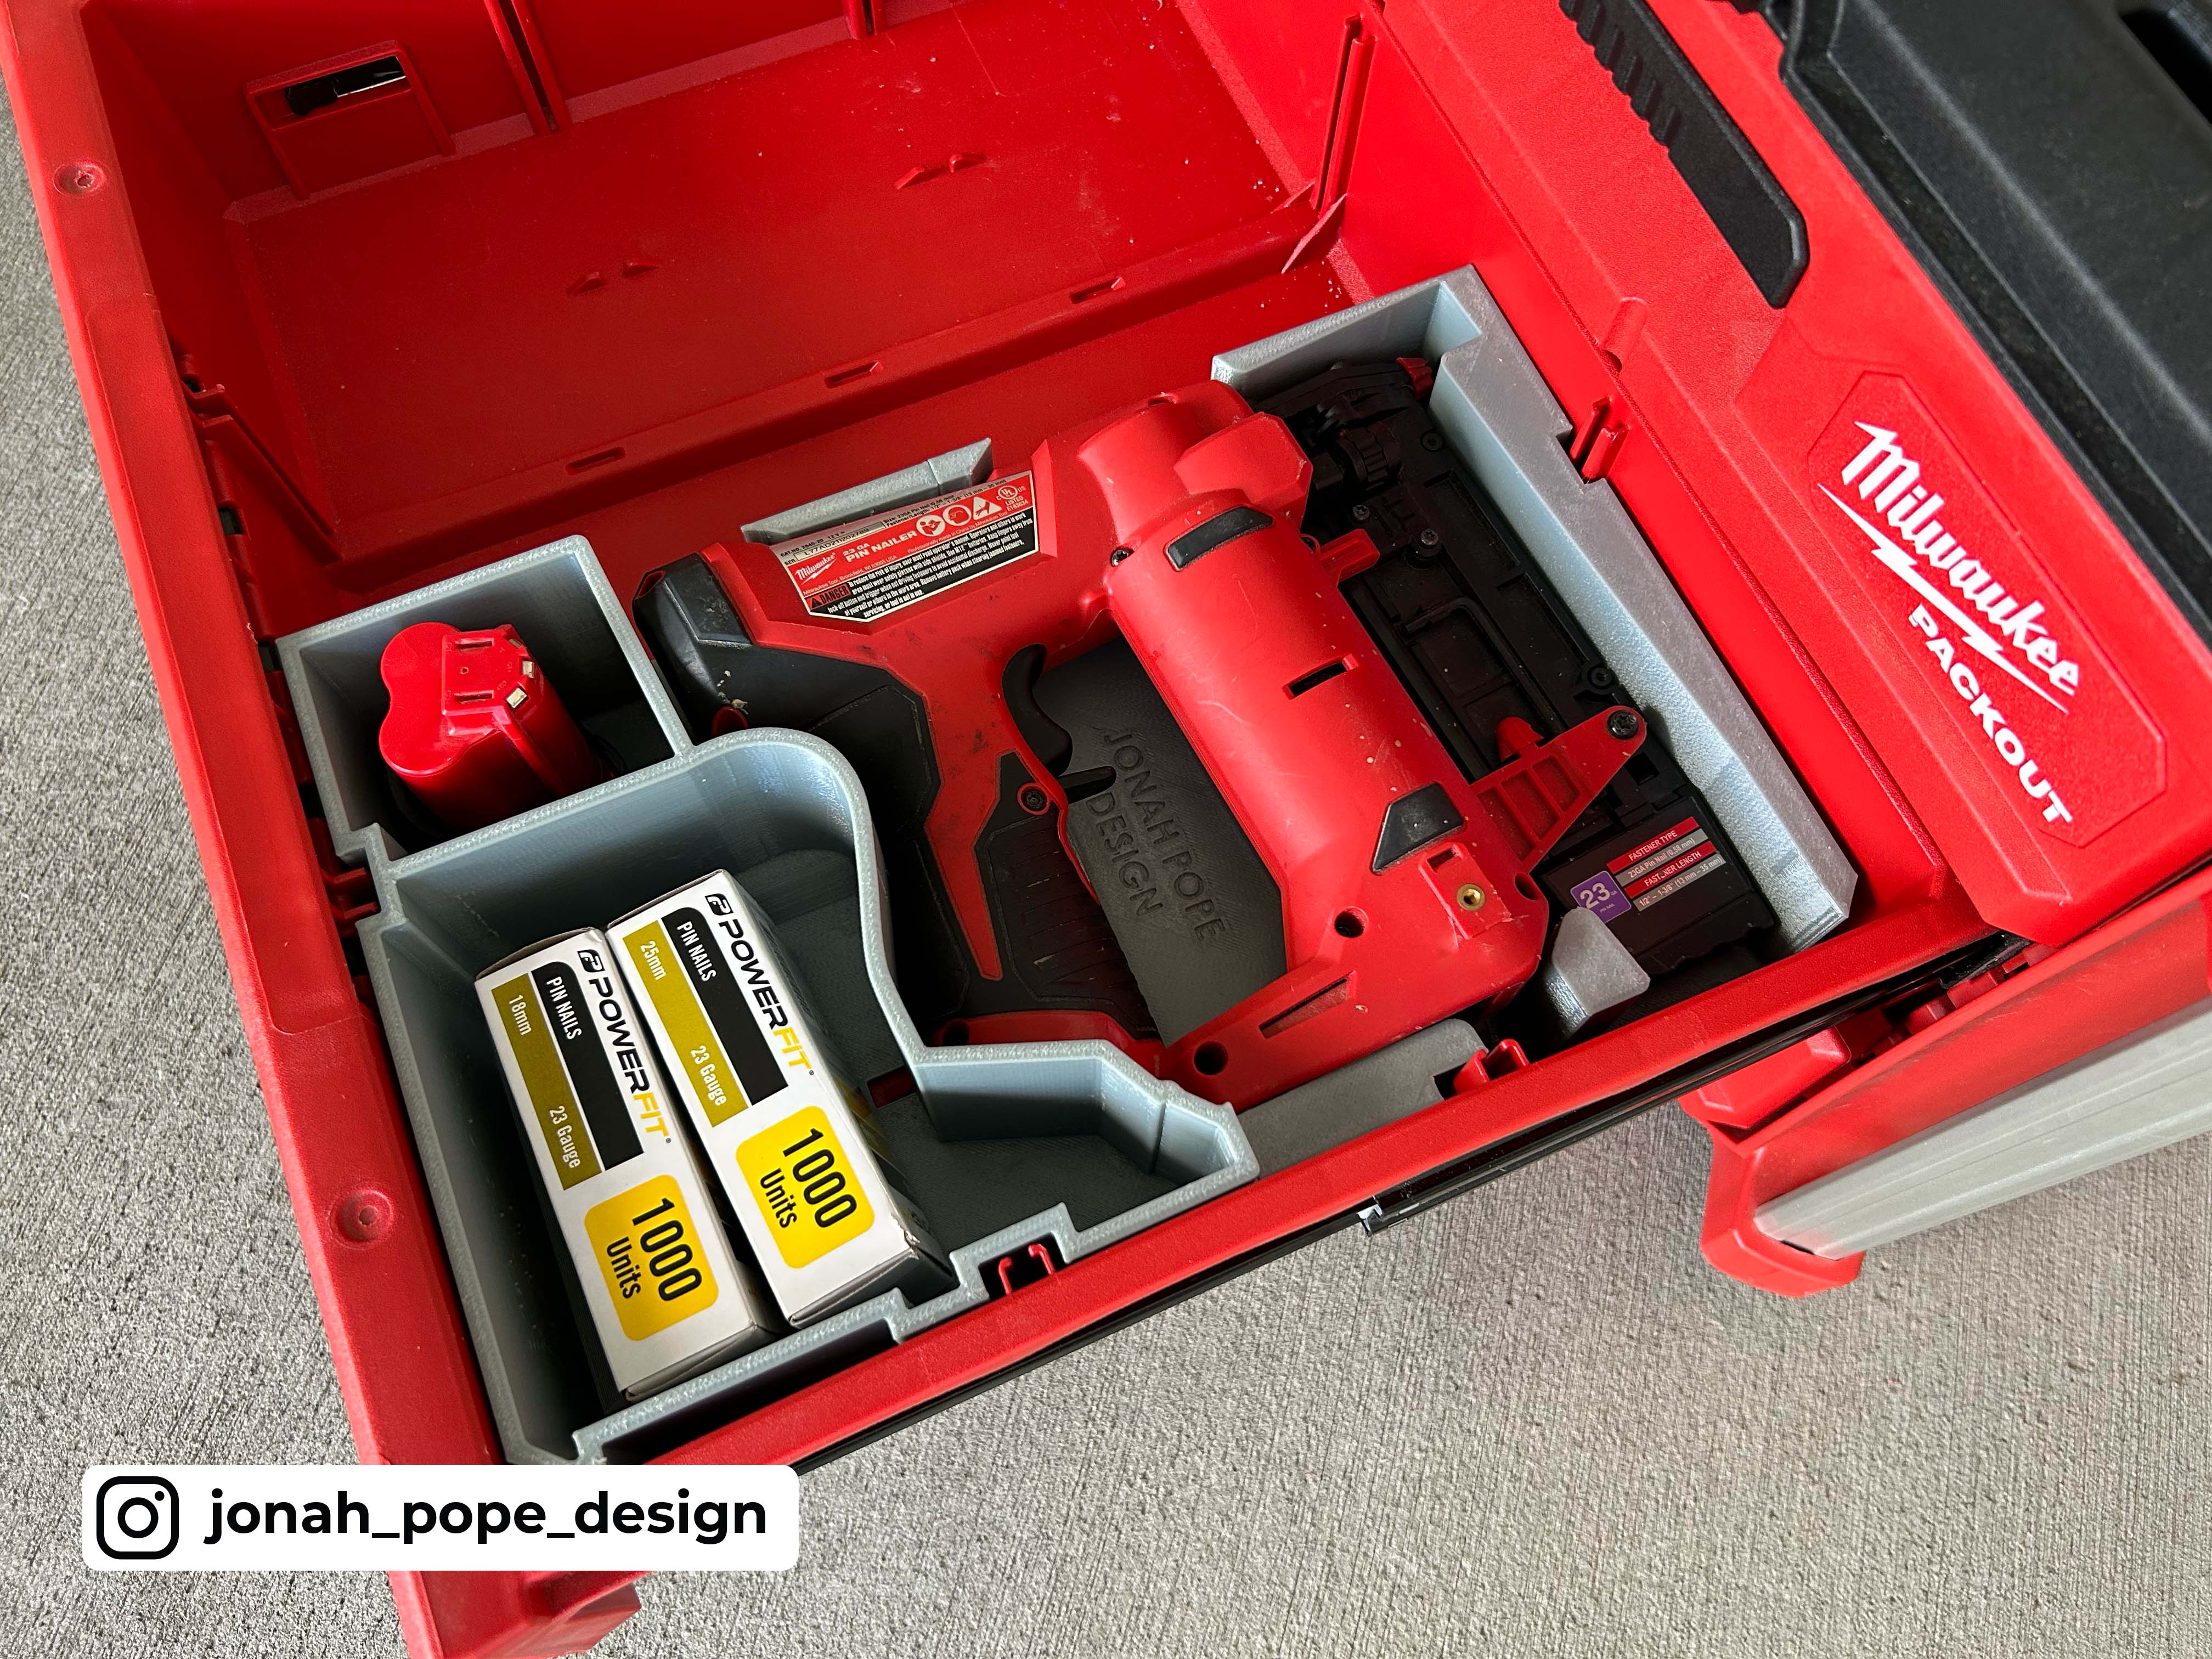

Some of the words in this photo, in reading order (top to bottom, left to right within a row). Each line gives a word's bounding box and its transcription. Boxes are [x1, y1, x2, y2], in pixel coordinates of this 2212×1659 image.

[1005, 495, 1024, 506] LISTED
[795, 554, 834, 579] Milwaukee
[842, 547, 856, 556] 23
[856, 542, 870, 550] GA
[845, 548, 869, 562] PIN
[871, 529, 917, 552] NAILER
[851, 586, 863, 595] area
[861, 582, 873, 591] must
[872, 577, 885, 586] wear
[883, 571, 898, 583] safety
[912, 561, 923, 571] with
[921, 557, 932, 567] side
[946, 548, 956, 557] Use
[986, 531, 998, 541] Keep
[996, 525, 1013, 537] fingers
[1011, 521, 1024, 532] away
[1022, 517, 1032, 526] from
[853, 574, 869, 586] reduce
[874, 568, 885, 577] risk
[901, 557, 913, 566] user
[911, 552, 923, 562] must
[922, 549, 933, 558] read
[996, 517, 1011, 528] others
[1014, 511, 1026, 521] work
[1841, 421, 2078, 695] Milwaukee
[843, 596, 858, 607] button
[856, 592, 866, 602] and
[864, 586, 881, 600] trigger
[878, 582, 892, 592] when
[890, 579, 899, 588] not
[897, 573, 914, 586] driving
[935, 560, 949, 570] avoid
[987, 538, 1001, 549] Never
[1000, 534, 1012, 545] point
[1009, 531, 1019, 540] tool
[848, 601, 868, 616] yourself
[871, 593, 887, 605] others
[889, 589, 899, 597] the
[896, 584, 910, 595] work
[919, 573, 937, 585] Remove
[935, 567, 952, 580] battery
[950, 563, 962, 574] pack
[960, 558, 973, 569] when
[971, 551, 990, 565] clearing
[987, 545, 1005, 559] jammed
[819, 584, 849, 604] DANGER
[889, 597, 899, 607] tool
[902, 593, 911, 602] not
[1909, 605, 2072, 823] PACKOUT
[1086, 792, 1163, 917] DESIGN
[1104, 734, 1180, 844] JONAH
[1163, 851, 1226, 941] POPE
[1628, 839, 1660, 861] FASTENER
[1659, 829, 1678, 844] TYPE
[1628, 864, 1646, 878] 23GA
[1644, 859, 1656, 869] Pin
[1654, 852, 1667, 864] Nail
[1680, 837, 1696, 850] mm)
[1675, 850, 1702, 869] LENGTH
[1673, 876, 1686, 888] (13
[1684, 871, 1697, 882] mm
[1699, 863, 1709, 872] 35
[1707, 855, 1723, 868] mm)
[1579, 883, 1609, 909] 23
[640, 939, 667, 981] 25mm
[676, 920, 698, 949] PIN
[687, 947, 716, 982] NAILS
[545, 977, 566, 1005] PIN
[718, 920, 813, 1071] POWERFIT
[507, 993, 533, 1037] 18mm
[555, 1002, 583, 1040] NAILS
[586, 977, 670, 1138] POWERFIT
[690, 1044, 709, 1067] 23
[698, 1063, 728, 1107] Gauge
[549, 1104, 566, 1126] 23
[556, 1122, 582, 1170] Gauge
[759, 1167, 798, 1230] Units
[782, 1127, 859, 1229] 1000
[606, 1235, 642, 1300] Units
[631, 1196, 703, 1302] 1000
